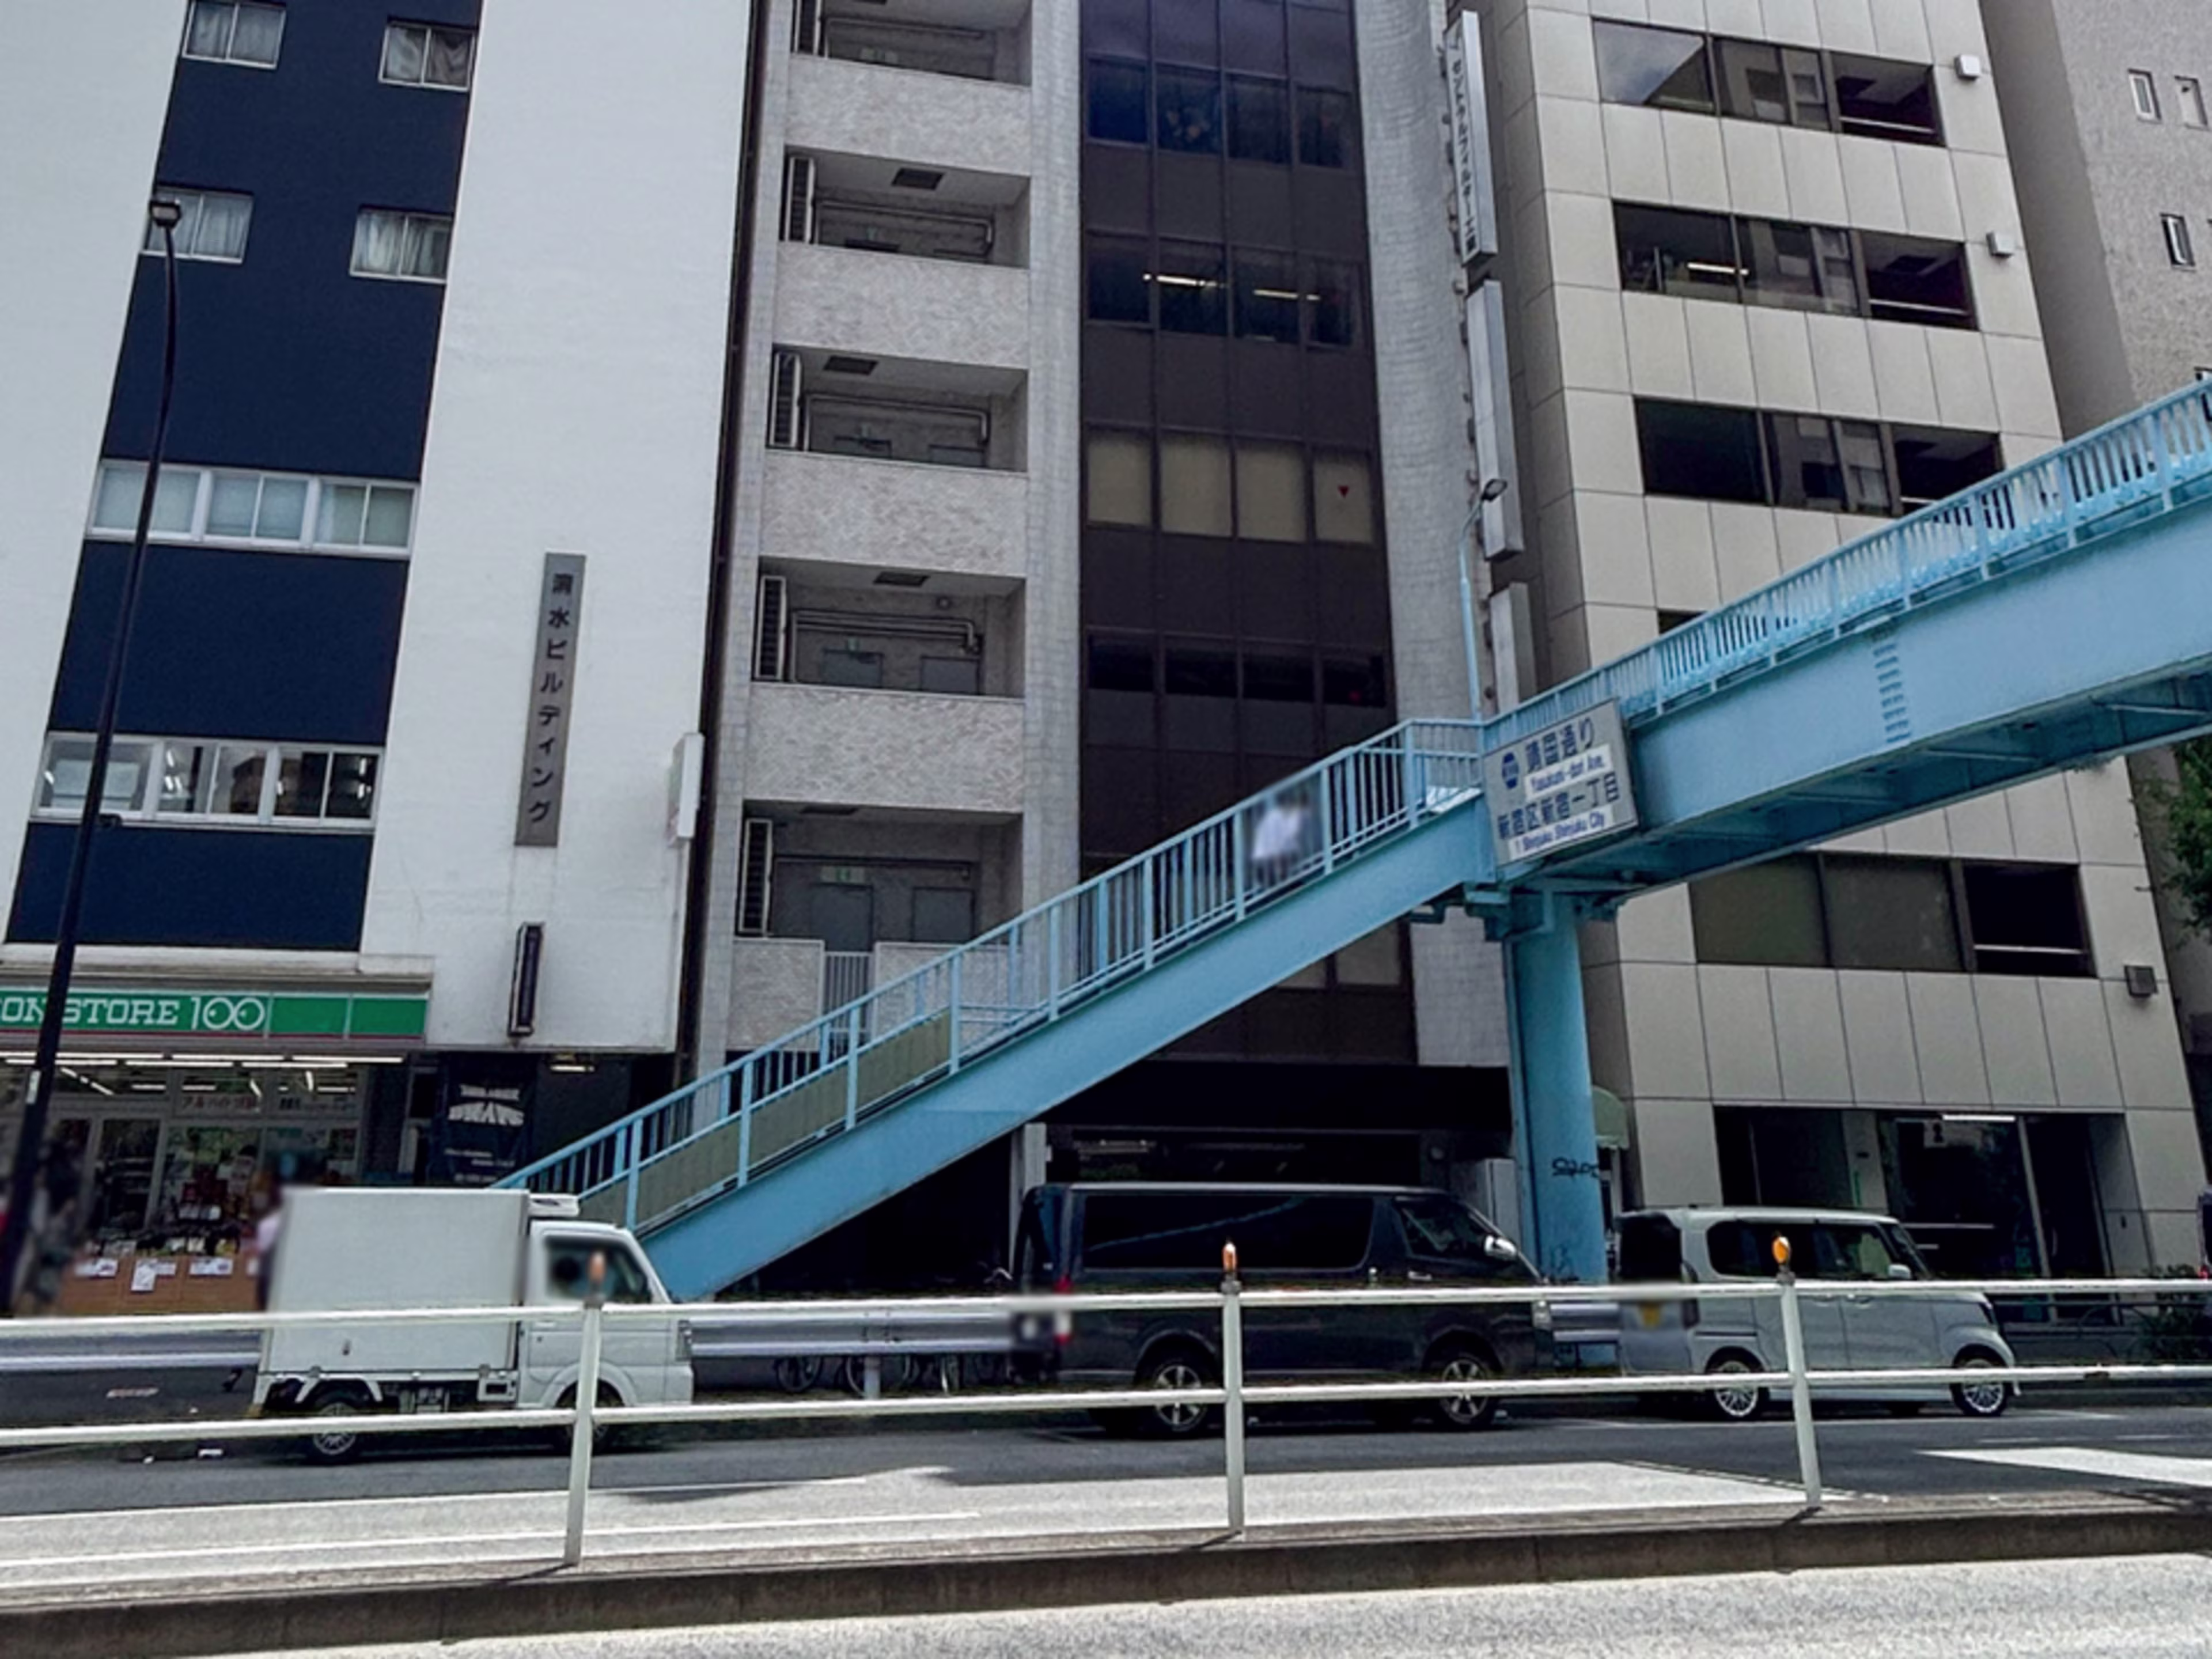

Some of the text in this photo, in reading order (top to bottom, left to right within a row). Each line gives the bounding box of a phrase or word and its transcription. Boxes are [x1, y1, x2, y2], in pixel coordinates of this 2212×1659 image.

[1498, 772, 1620, 840] 新宿区新宿一丁目
[1589, 811, 1605, 828] City
[62, 998, 180, 1025] STORE
[191, 996, 266, 1031] 100
